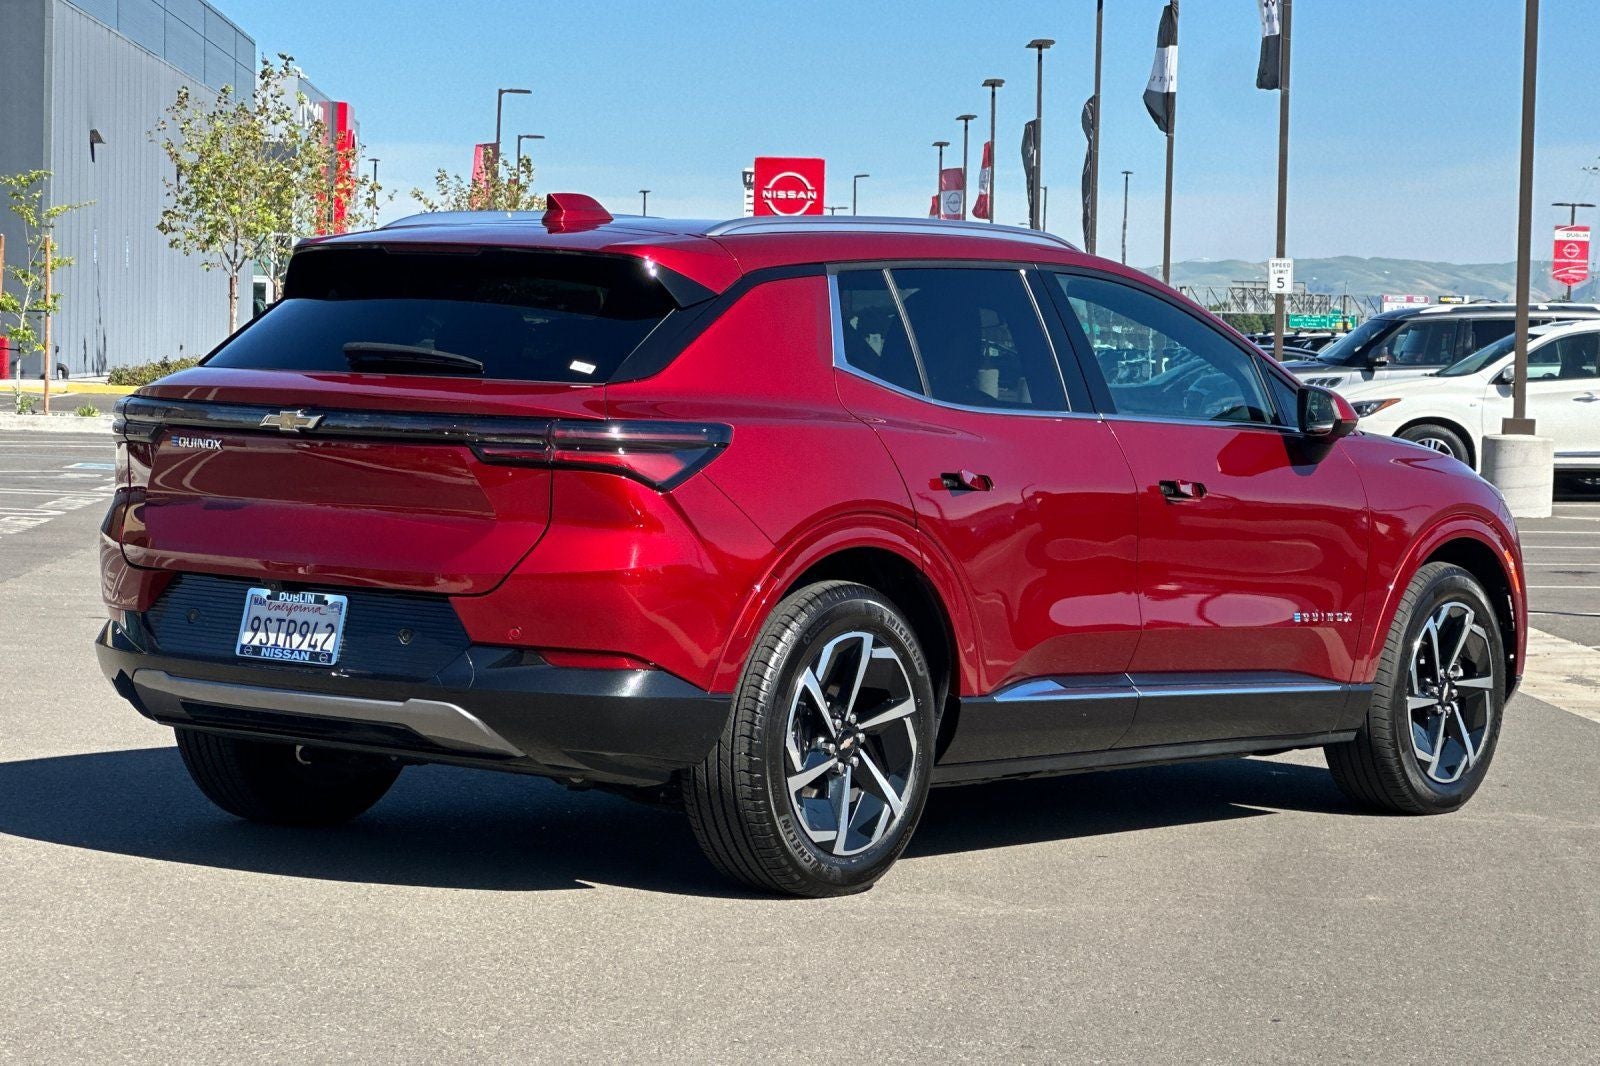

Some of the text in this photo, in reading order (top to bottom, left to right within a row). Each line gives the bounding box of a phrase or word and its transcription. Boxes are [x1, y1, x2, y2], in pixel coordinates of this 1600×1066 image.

[762, 190, 817, 199] NISSAN
[1276, 277, 1285, 289] 5
[171, 435, 223, 450] EQUINOX
[279, 592, 315, 604] DUBLIN
[267, 600, 327, 617] California
[260, 647, 310, 661] NISSAN
